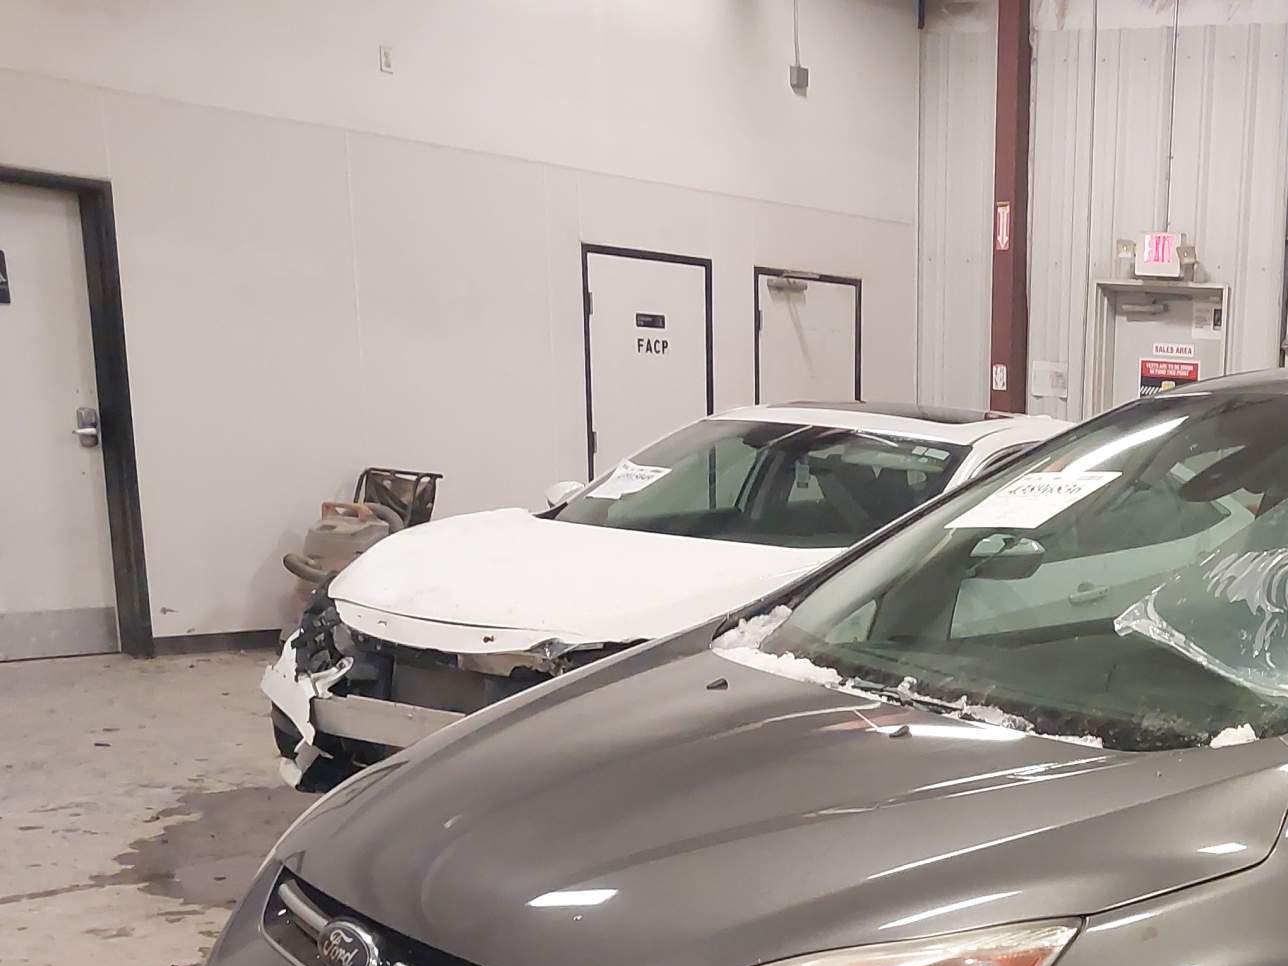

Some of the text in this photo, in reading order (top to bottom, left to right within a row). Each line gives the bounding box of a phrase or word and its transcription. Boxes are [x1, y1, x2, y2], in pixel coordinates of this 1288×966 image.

[1143, 234, 1175, 263] EXIT
[637, 338, 669, 354] FACP
[1155, 345, 1192, 354] SALES AREA
